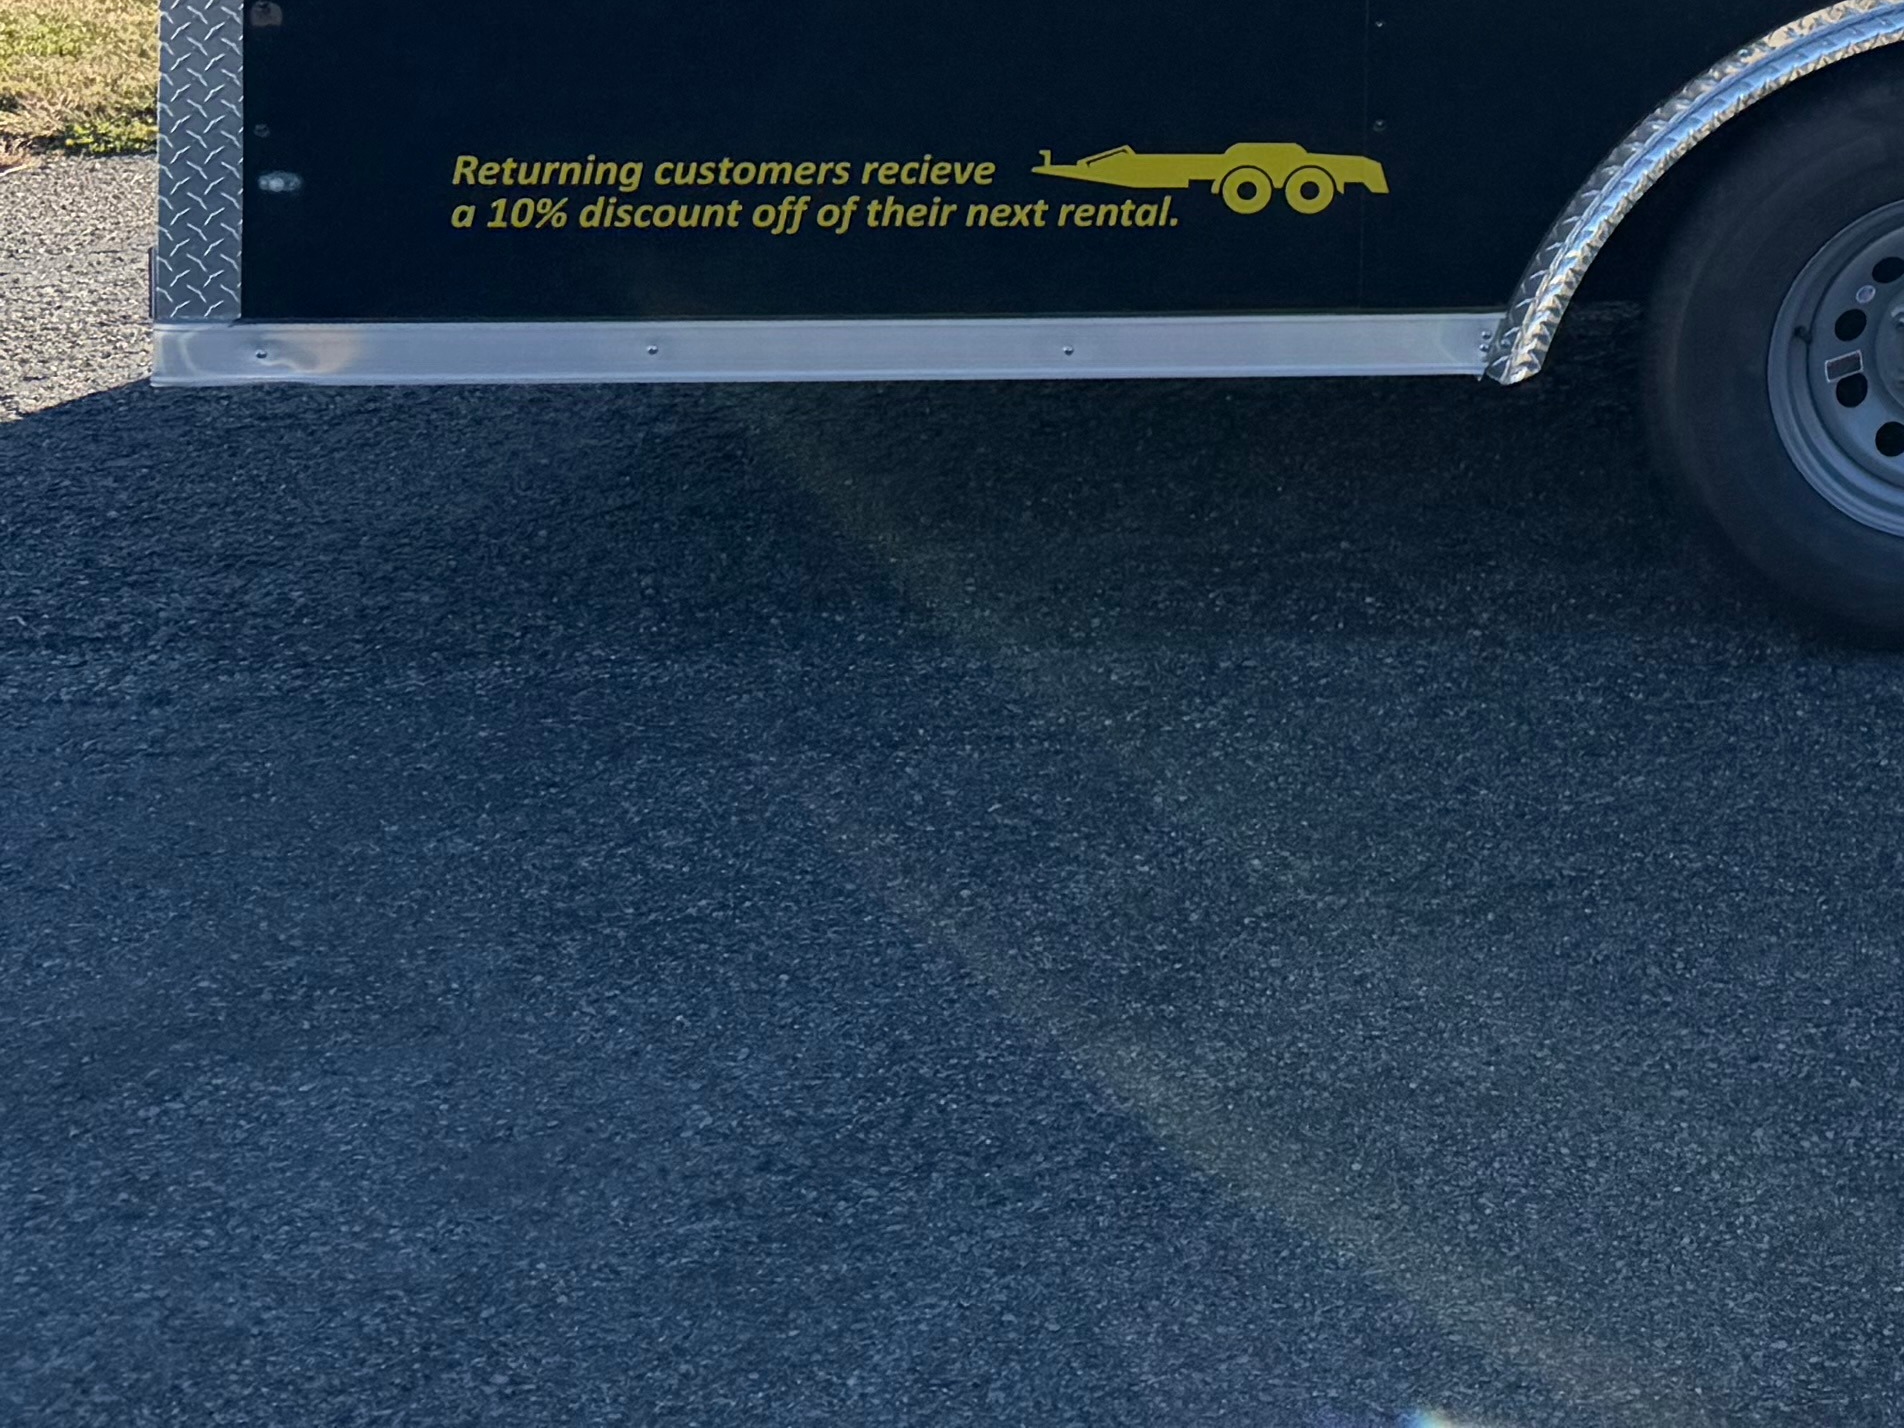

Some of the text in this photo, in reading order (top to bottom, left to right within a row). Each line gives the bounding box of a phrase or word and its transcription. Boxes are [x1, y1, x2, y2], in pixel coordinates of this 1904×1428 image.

[451, 153, 997, 193] Returning customers recieve
[449, 194, 1180, 236] a 10% discount off of their next rental.
